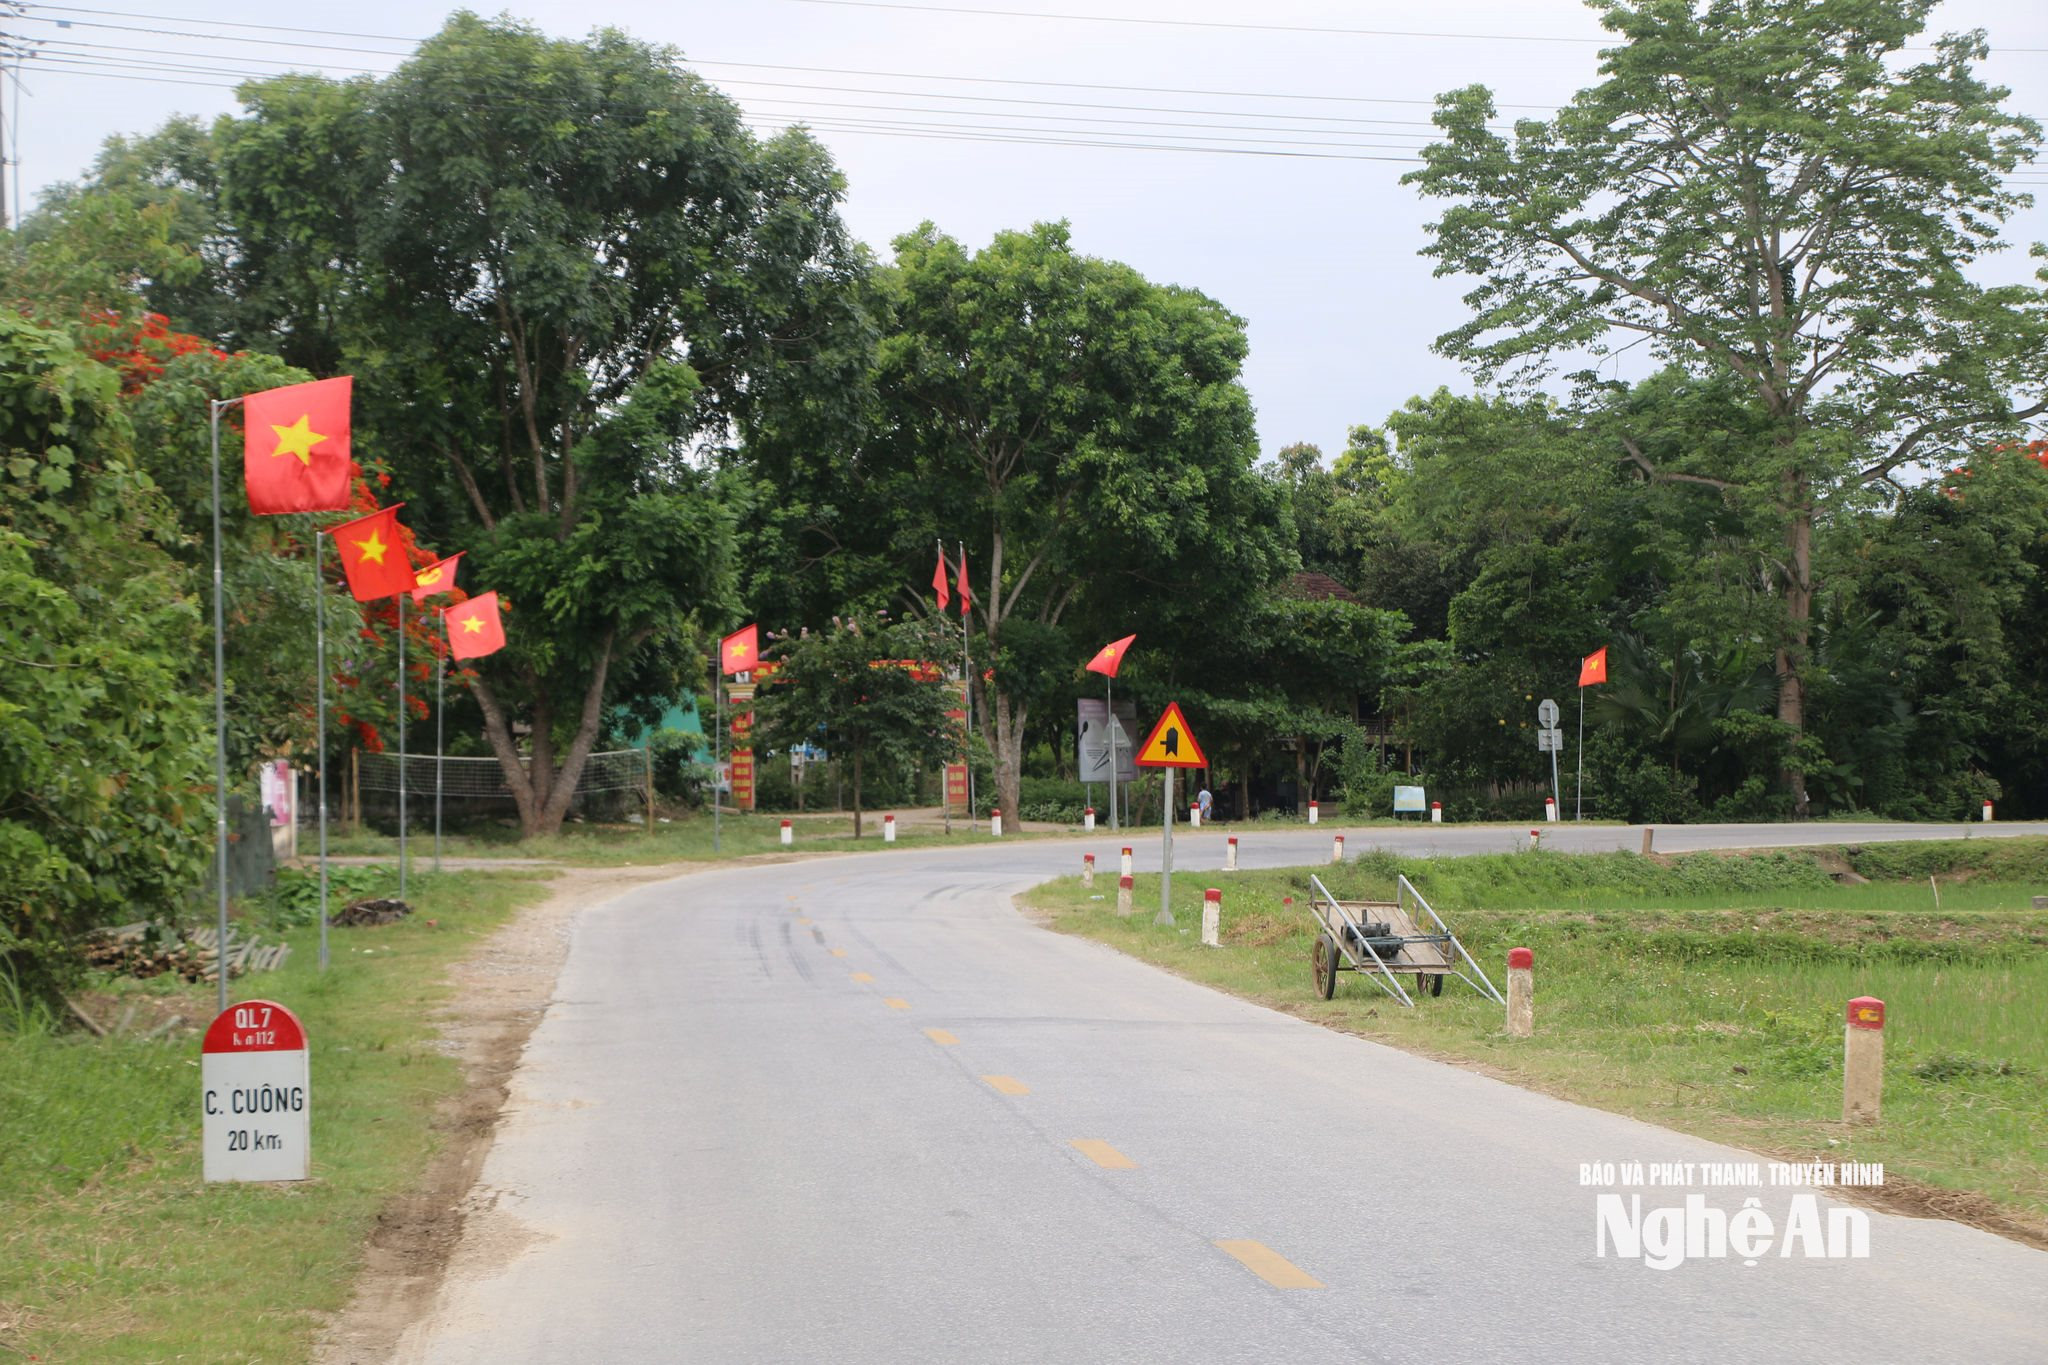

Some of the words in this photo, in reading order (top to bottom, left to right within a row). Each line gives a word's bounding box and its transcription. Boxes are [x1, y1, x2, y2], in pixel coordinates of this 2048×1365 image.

[235, 1007, 272, 1029] QL7
[205, 1090, 224, 1115] C.
[232, 1083, 304, 1114] CUÔNG
[228, 1130, 248, 1151] 20
[254, 1129, 282, 1150] km
